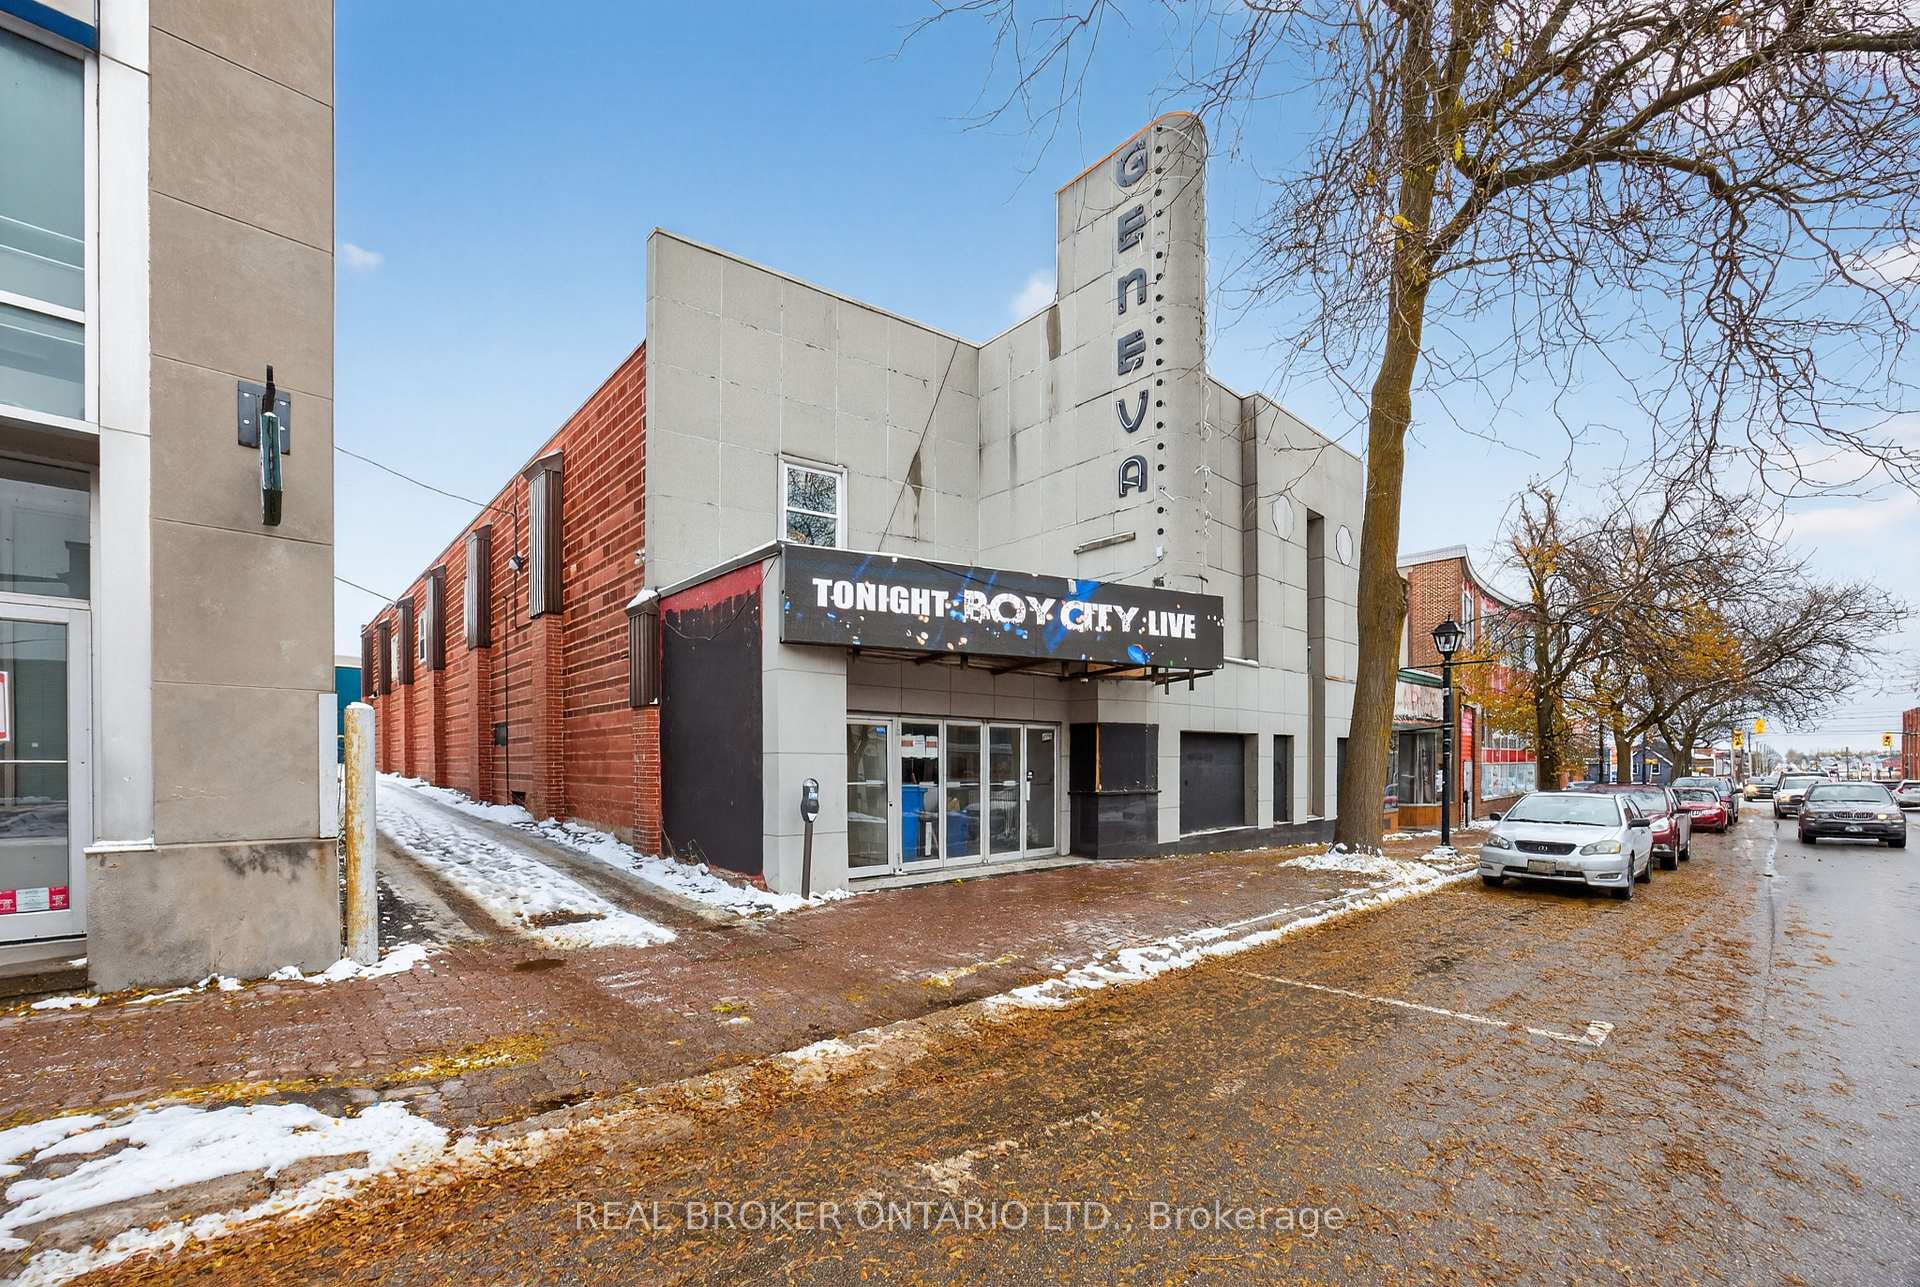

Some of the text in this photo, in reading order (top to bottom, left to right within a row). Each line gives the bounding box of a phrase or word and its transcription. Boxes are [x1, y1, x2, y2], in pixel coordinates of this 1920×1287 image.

[1115, 138, 1148, 498] GENEVA
[812, 577, 1196, 639] TONIGHT BOY CITY LIVE
